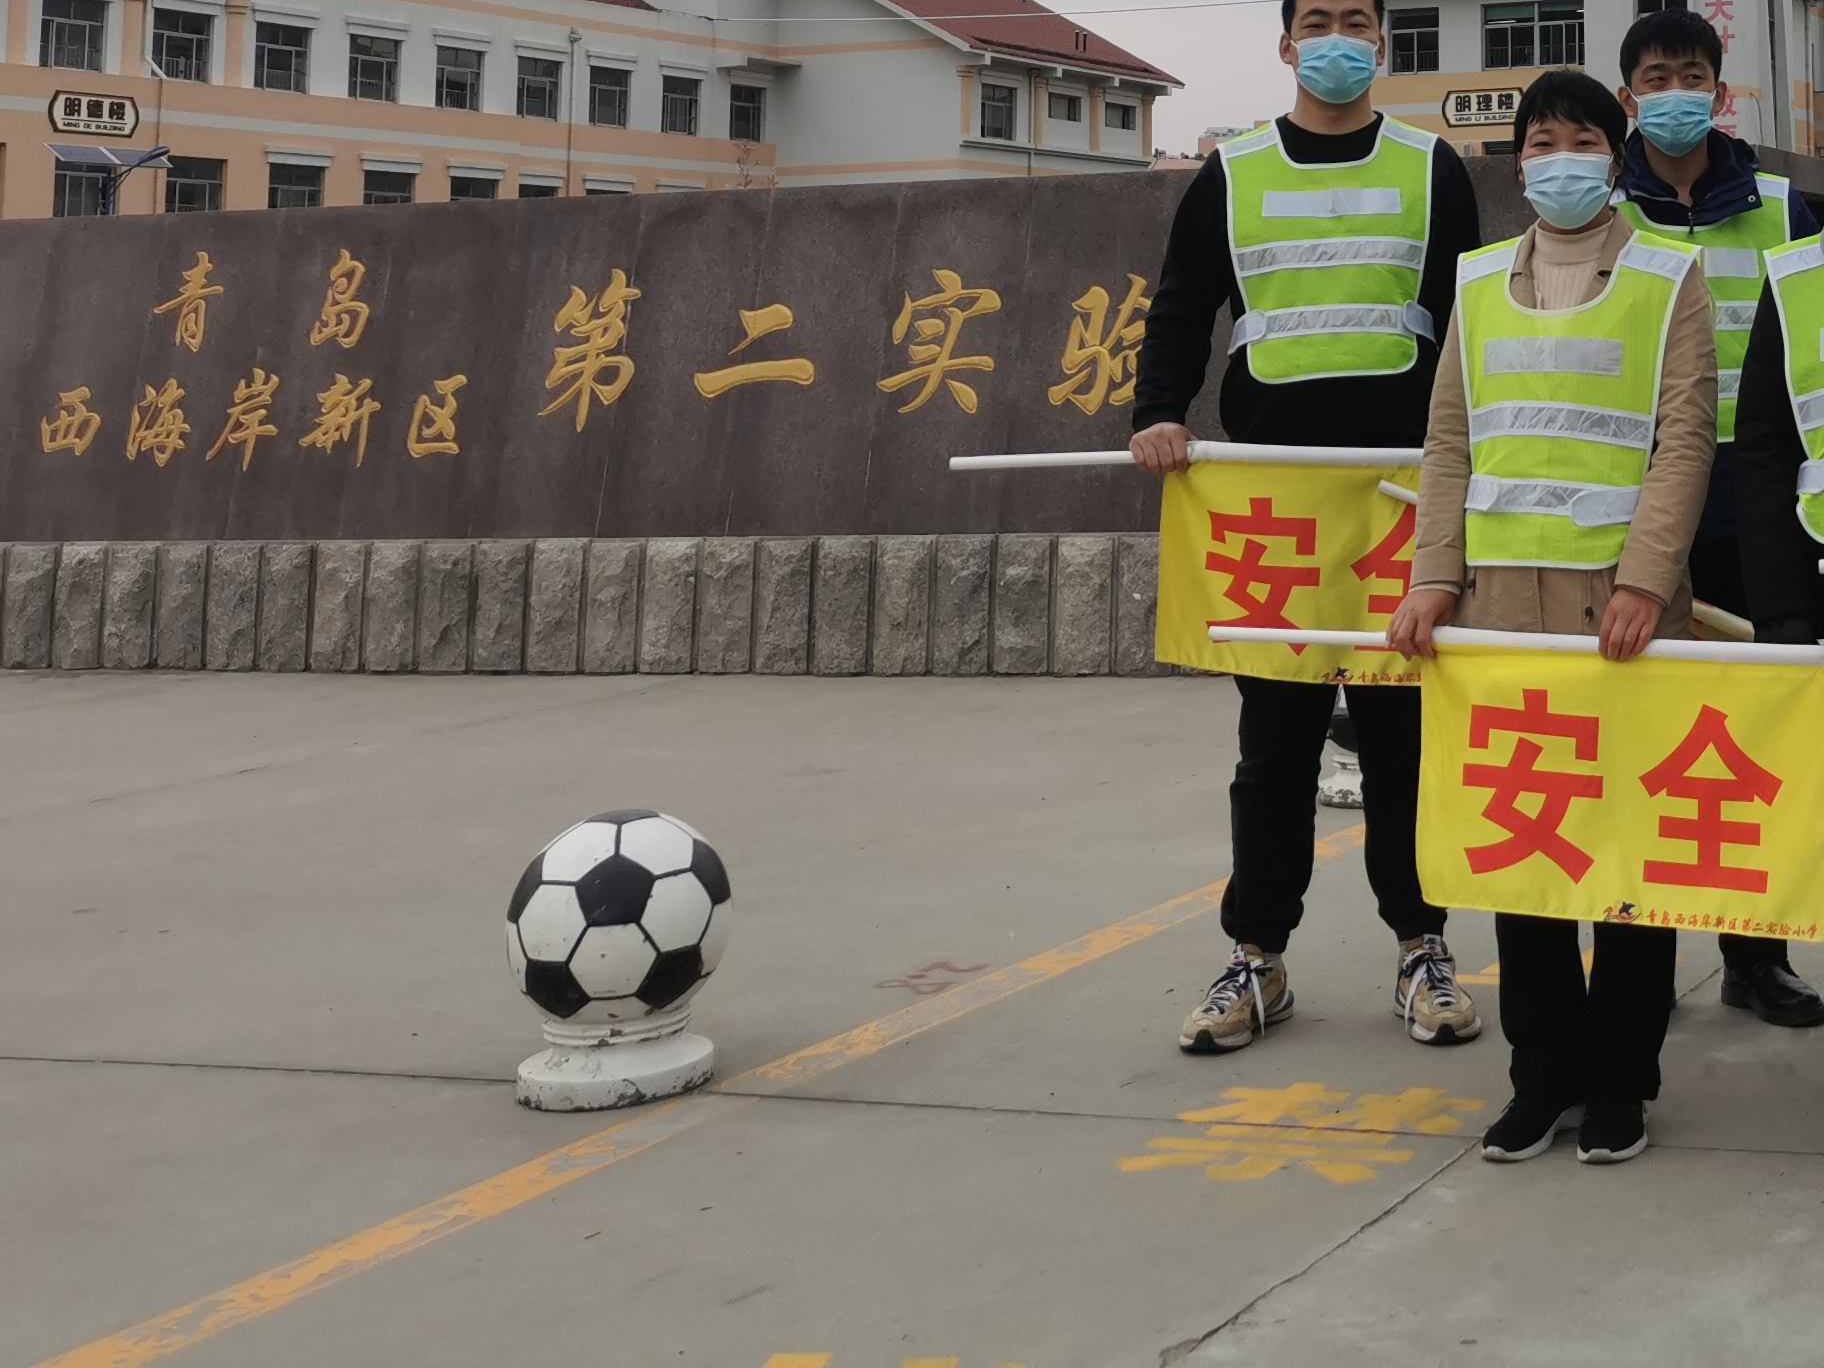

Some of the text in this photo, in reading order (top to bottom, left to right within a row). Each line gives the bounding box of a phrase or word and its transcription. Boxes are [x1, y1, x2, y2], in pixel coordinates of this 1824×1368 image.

[63, 97, 126, 120] 明德楼
[1455, 92, 1515, 112] 明理楼
[153, 248, 371, 352] 青岛
[537, 268, 1151, 433] 第二实验
[41, 367, 469, 472] 西海岸新区
[1462, 689, 1783, 895] 安全
[1645, 907, 1819, 941] 青岛西海岸新区第二实验小学
[1116, 1081, 1488, 1186] 禁
